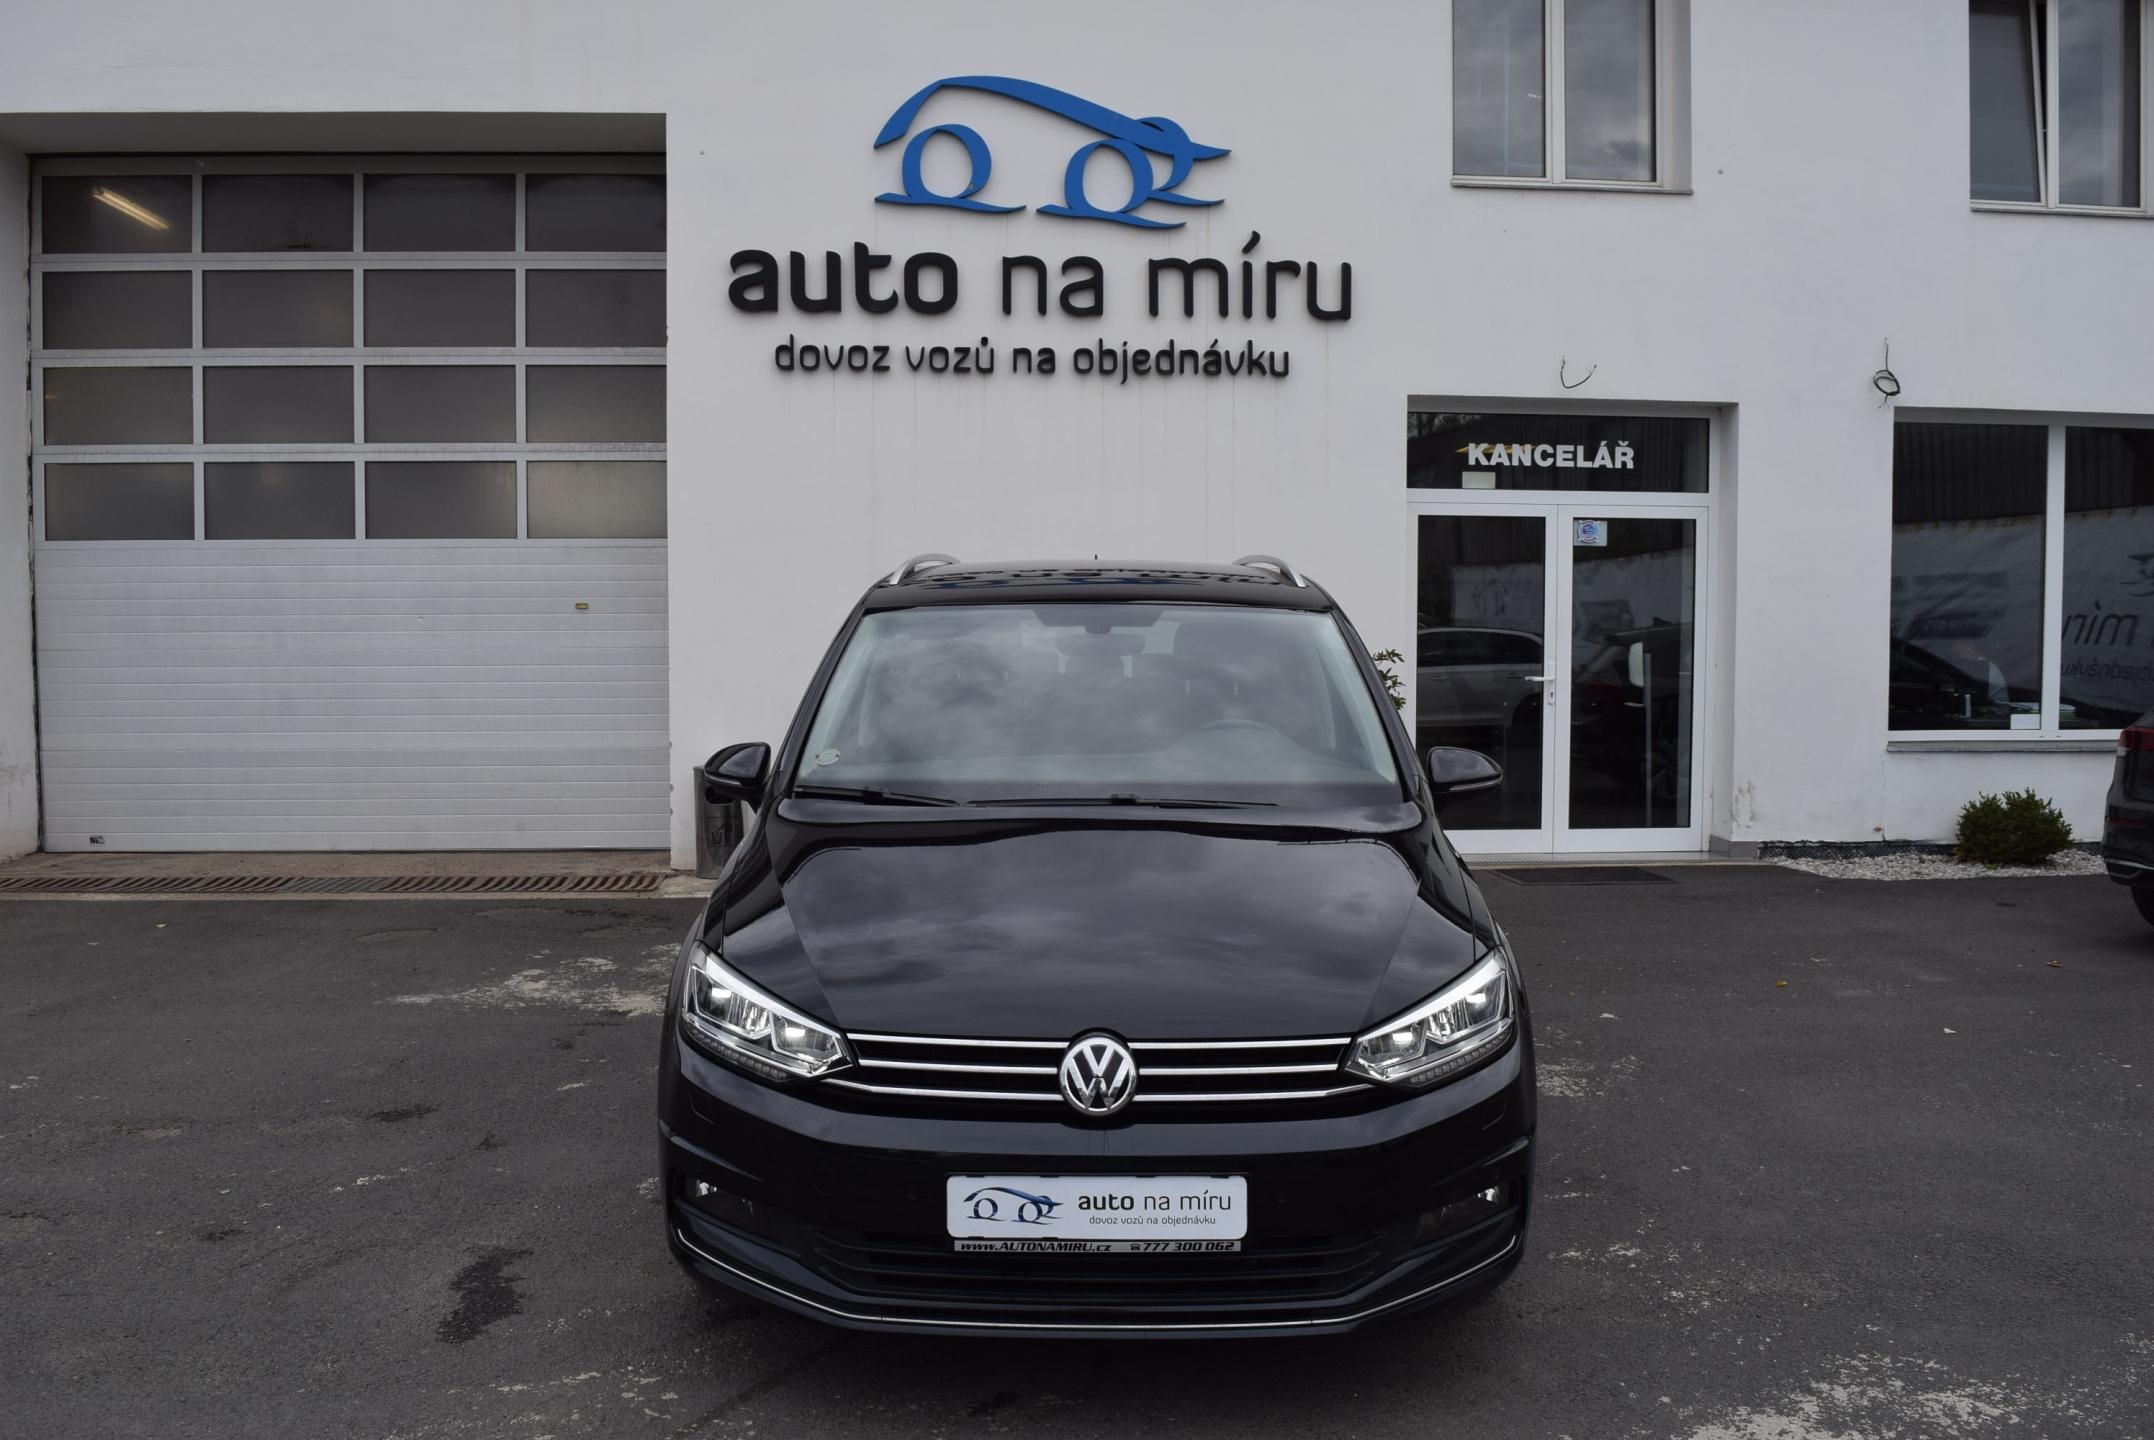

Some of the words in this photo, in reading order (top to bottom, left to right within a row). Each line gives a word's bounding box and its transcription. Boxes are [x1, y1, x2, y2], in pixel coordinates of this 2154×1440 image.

[727, 241, 959, 314] auto
[1001, 255, 1104, 318] na
[1147, 230, 1352, 320] míru
[774, 333, 891, 375] dovoz
[905, 336, 995, 376] vozů
[1012, 345, 1056, 376] na
[1072, 337, 1290, 385] objednávku
[1467, 440, 1635, 469] KANCELÁŘ
[1078, 1193, 1135, 1211] auto
[1143, 1195, 1171, 1211] na
[1179, 1189, 1232, 1211] míru
[1088, 1215, 1118, 1225] dovoz
[1120, 1215, 1144, 1225] vozů
[1146, 1217, 1159, 1225] na
[1161, 1215, 1216, 1227] objednávku
[960, 1241, 1112, 1252] www.AUTONAMIRU.cz
[1143, 1242, 1171, 1252] 777
[1174, 1242, 1203, 1252] 300
[1204, 1242, 1235, 1251] 062
